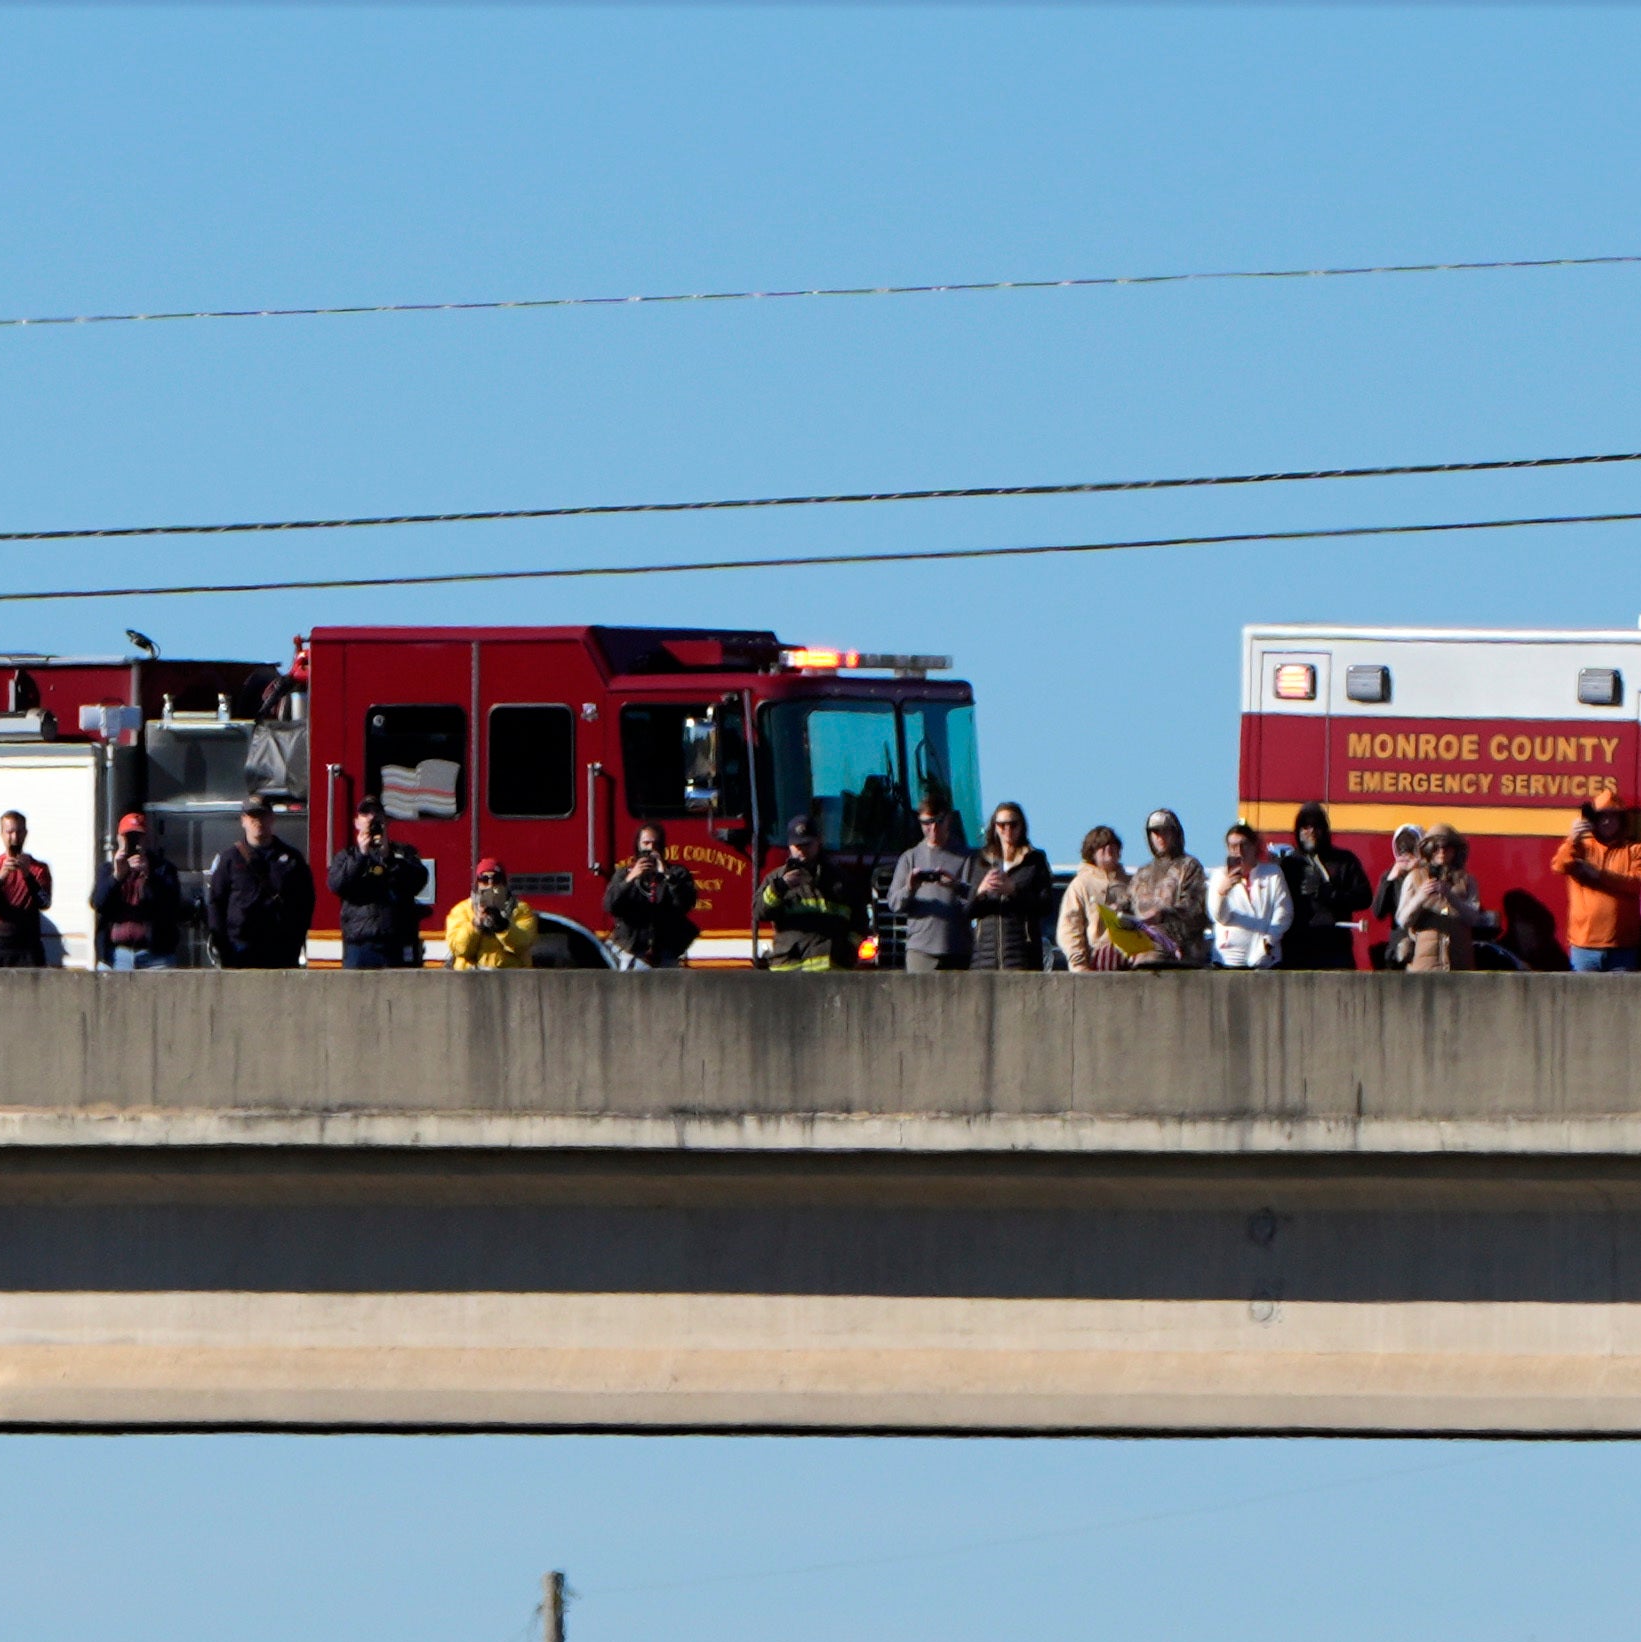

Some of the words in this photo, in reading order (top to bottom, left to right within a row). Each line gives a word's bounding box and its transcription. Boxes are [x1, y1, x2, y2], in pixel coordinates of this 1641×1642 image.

[1348, 733, 1480, 761] MONROE
[1490, 735, 1620, 764] COUNTY
[1348, 770, 1493, 794] EMERGENCY
[1500, 773, 1618, 797] SERVICES
[683, 845, 747, 876] COUNTY
